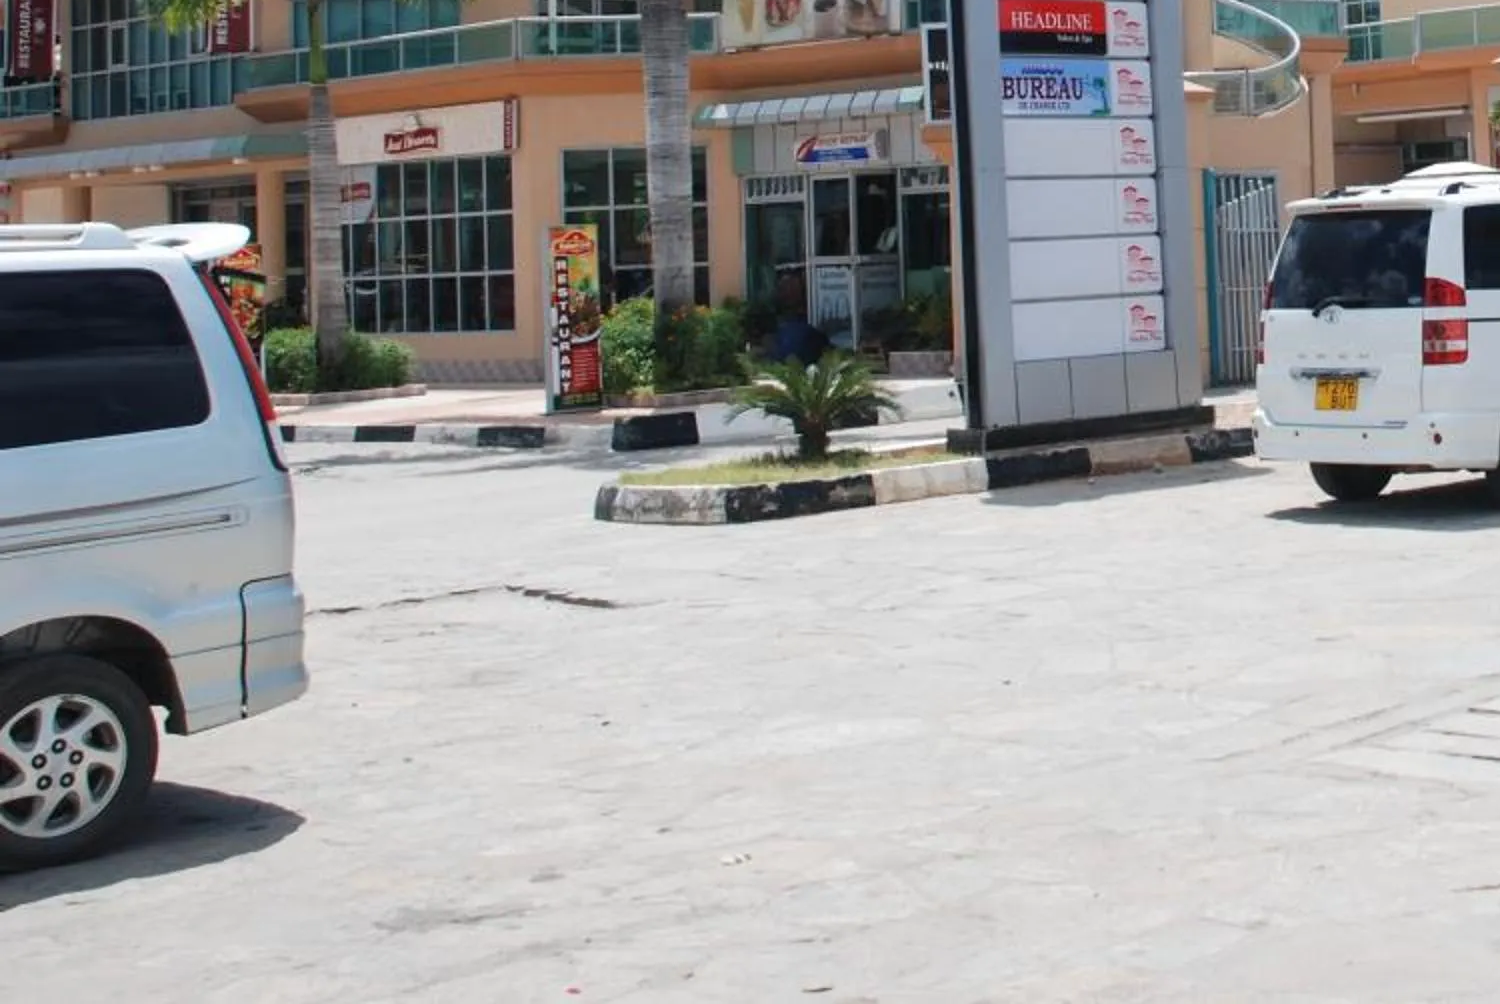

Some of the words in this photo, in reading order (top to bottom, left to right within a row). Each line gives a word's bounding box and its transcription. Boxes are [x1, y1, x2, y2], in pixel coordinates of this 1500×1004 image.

[1011, 11, 1093, 31] HEADLINE
[1002, 76, 1084, 100] BUREAU
[555, 258, 572, 394] RESTAURANT
